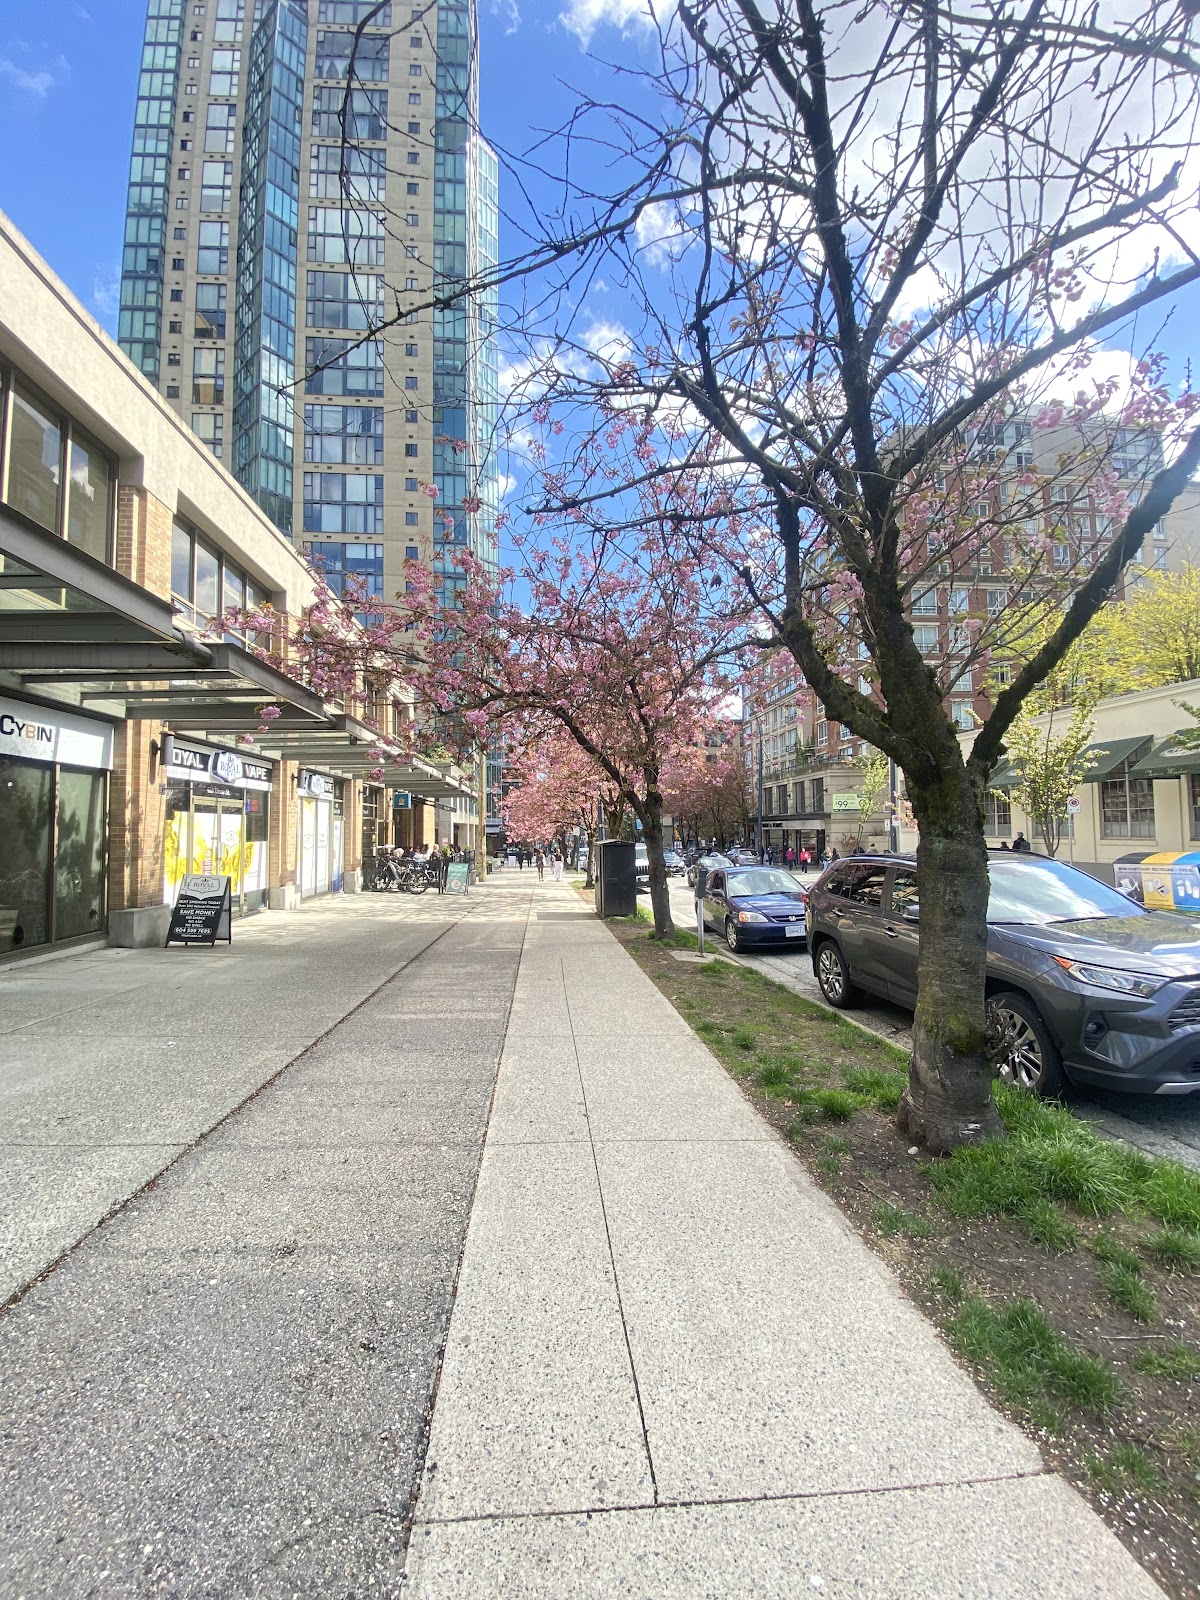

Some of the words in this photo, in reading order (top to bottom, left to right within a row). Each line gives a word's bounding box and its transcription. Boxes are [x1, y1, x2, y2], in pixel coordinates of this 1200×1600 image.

[0, 714, 52, 742] CYBIN
[173, 749, 204, 769] OYAL
[245, 764, 268, 780] VAPE
[220, 761, 240, 773] ROYAL
